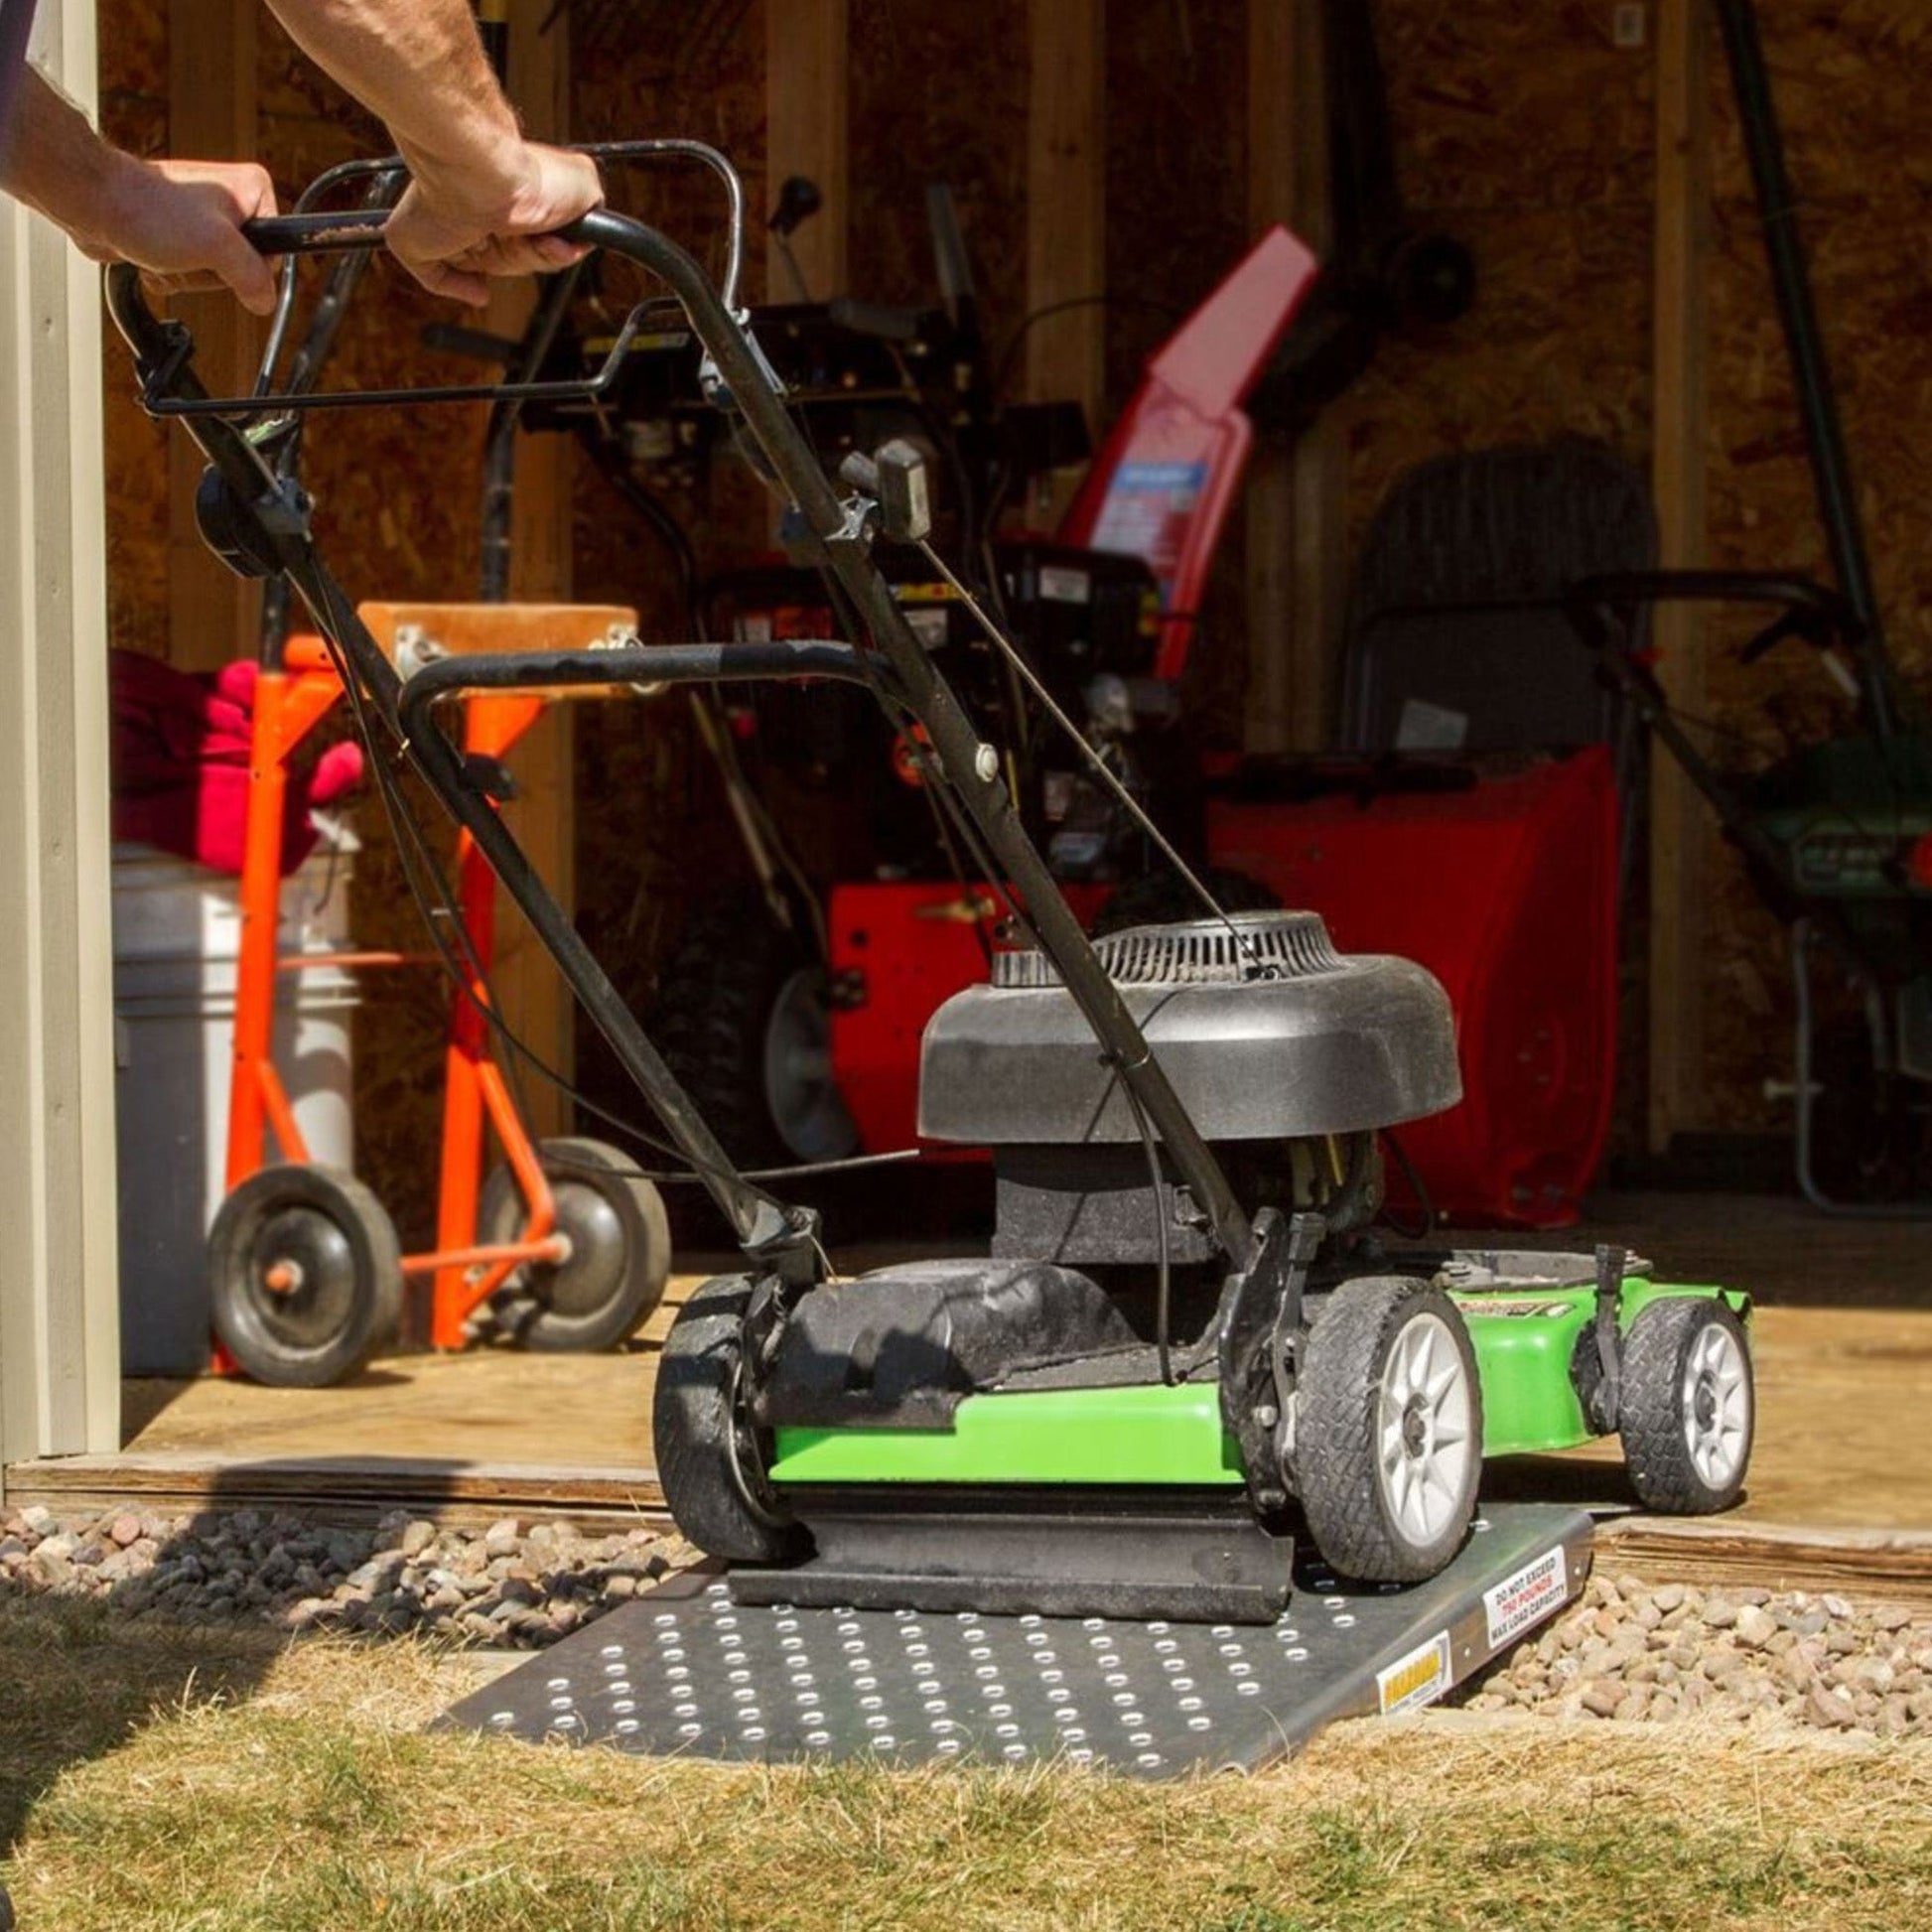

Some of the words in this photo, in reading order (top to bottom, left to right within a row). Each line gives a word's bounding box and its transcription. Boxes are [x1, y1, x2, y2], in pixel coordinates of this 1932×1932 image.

[1495, 1589, 1508, 1605] DO
[1509, 1578, 1525, 1594] NOT
[1526, 1557, 1556, 1585] EXCEED
[1491, 1622, 1508, 1641] MAX
[1509, 1608, 1528, 1629] LOAD
